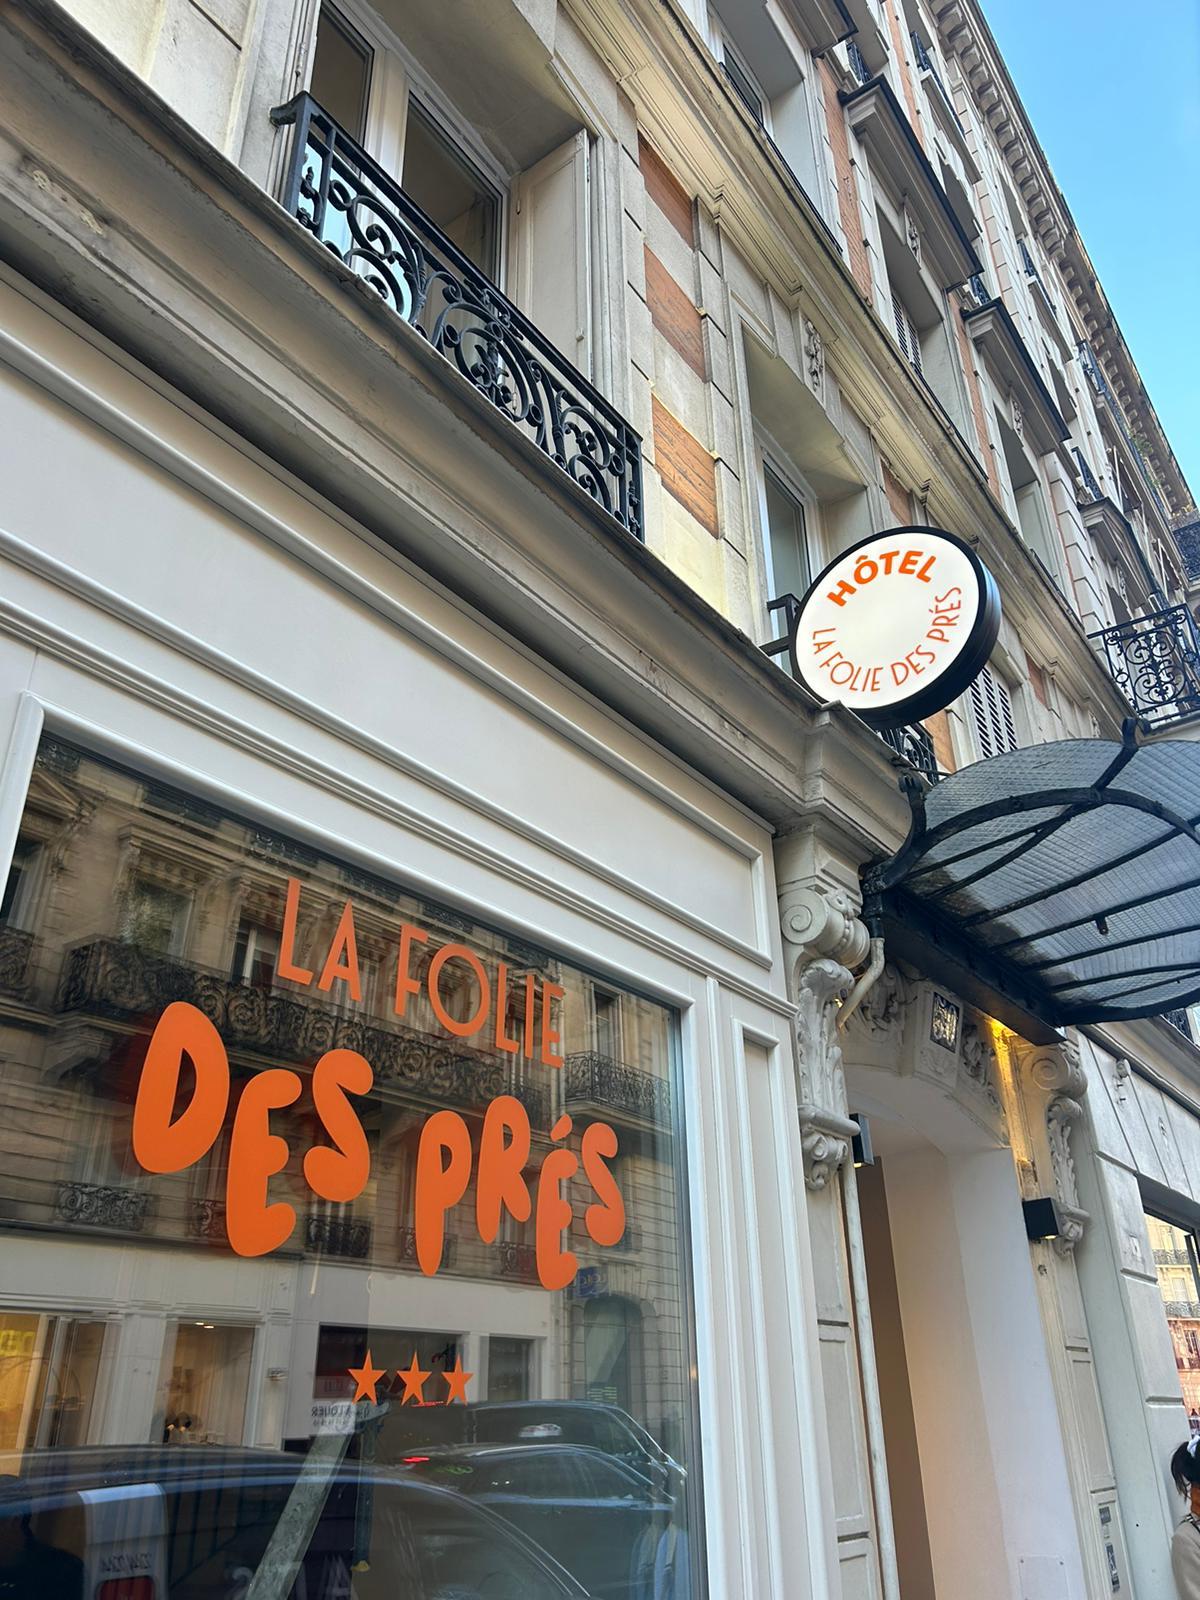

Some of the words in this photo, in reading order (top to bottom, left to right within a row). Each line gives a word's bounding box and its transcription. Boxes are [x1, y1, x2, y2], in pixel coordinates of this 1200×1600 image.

[827, 550, 937, 608] HÔTEL
[813, 628, 836, 655] LA
[926, 587, 962, 644] PRÉS
[819, 652, 883, 692] FOLIE
[890, 644, 936, 687] DES
[277, 876, 361, 1002] LA
[395, 923, 564, 1068] FOLIE
[132, 1001, 372, 1258] DES
[414, 1096, 625, 1290] PRÉS
